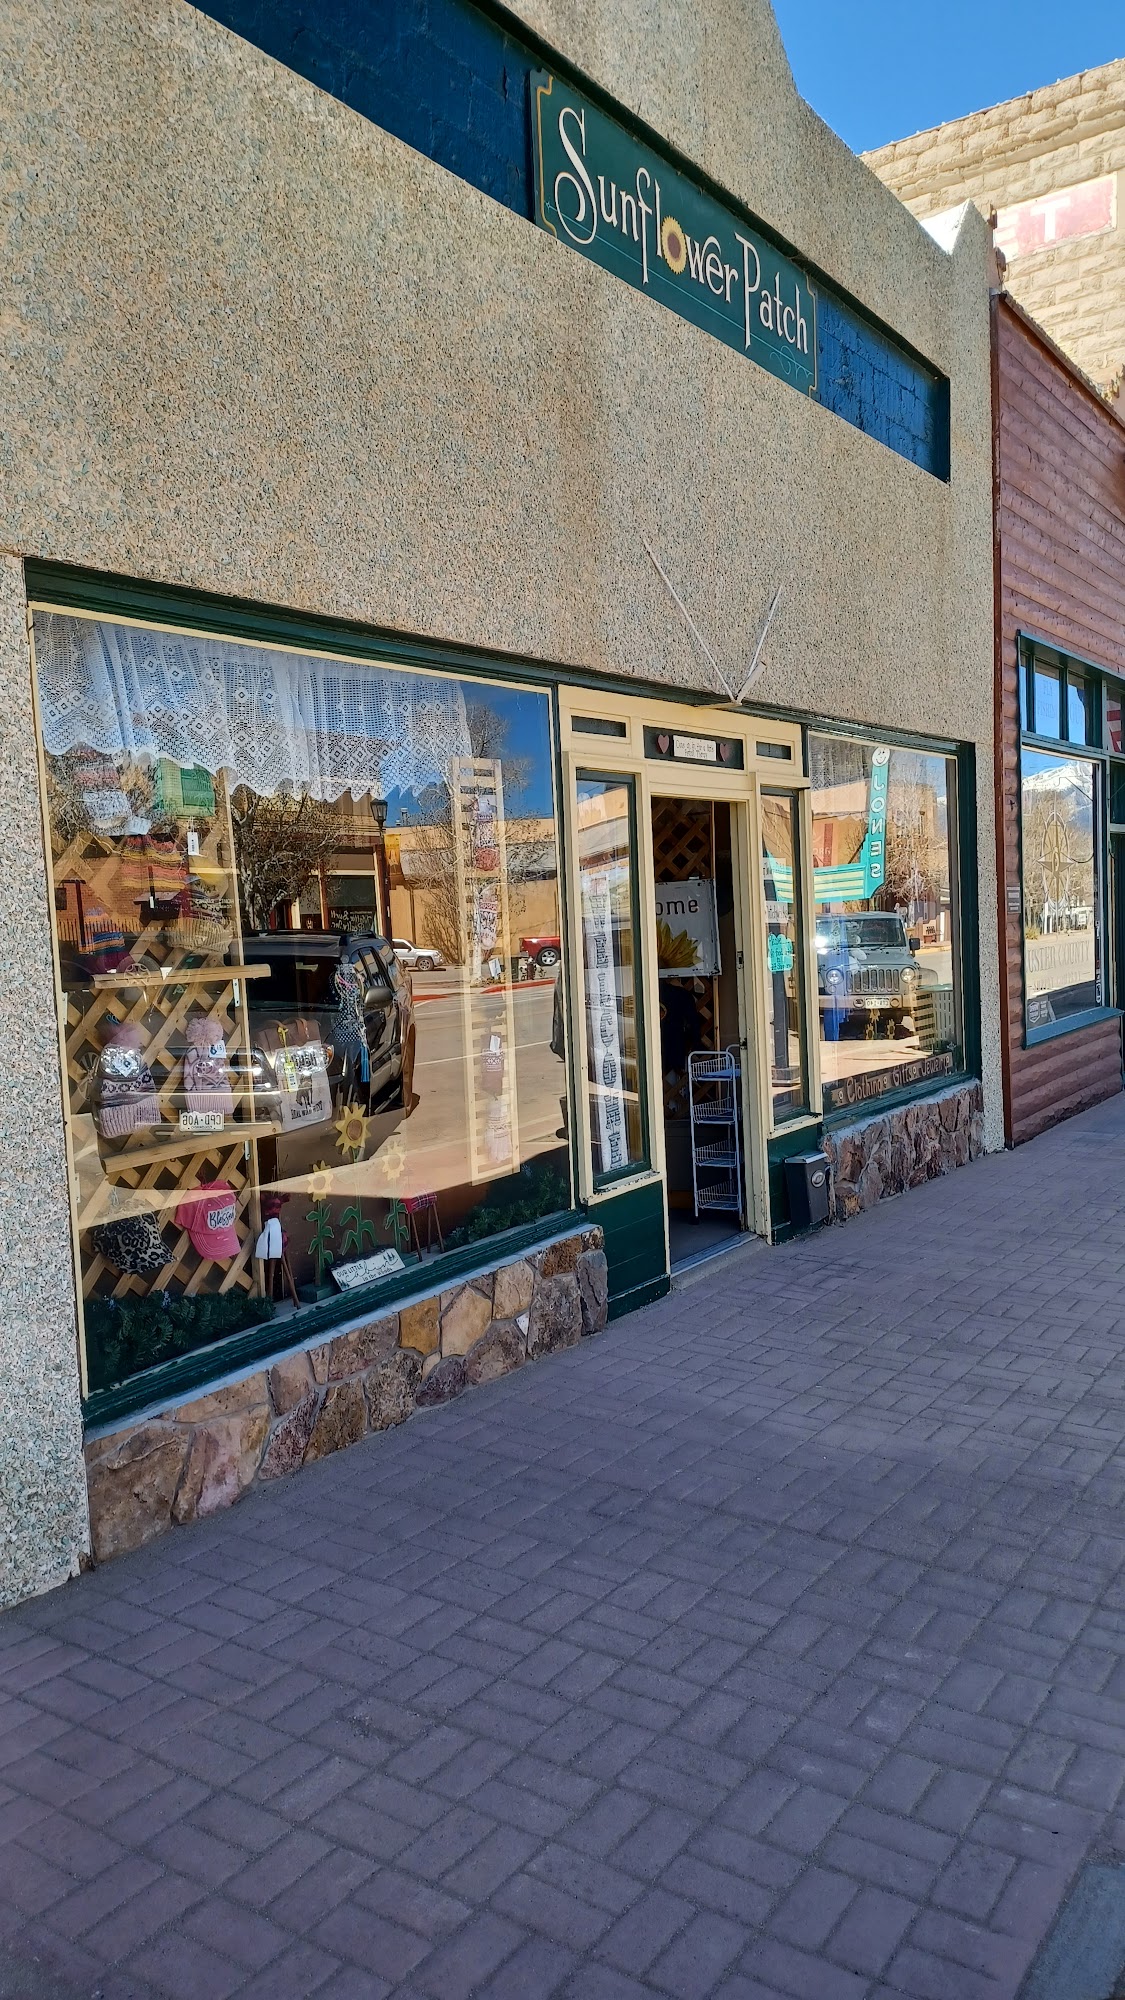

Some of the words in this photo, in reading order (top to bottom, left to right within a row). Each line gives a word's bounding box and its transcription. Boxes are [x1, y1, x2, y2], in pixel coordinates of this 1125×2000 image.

[735, 232, 809, 354] Patch
[847, 1077, 884, 1103] Clothing
[892, 1065, 912, 1087] Gifts
[336, 1269, 348, 1278] OUR
[347, 1263, 364, 1274] LITTLE
